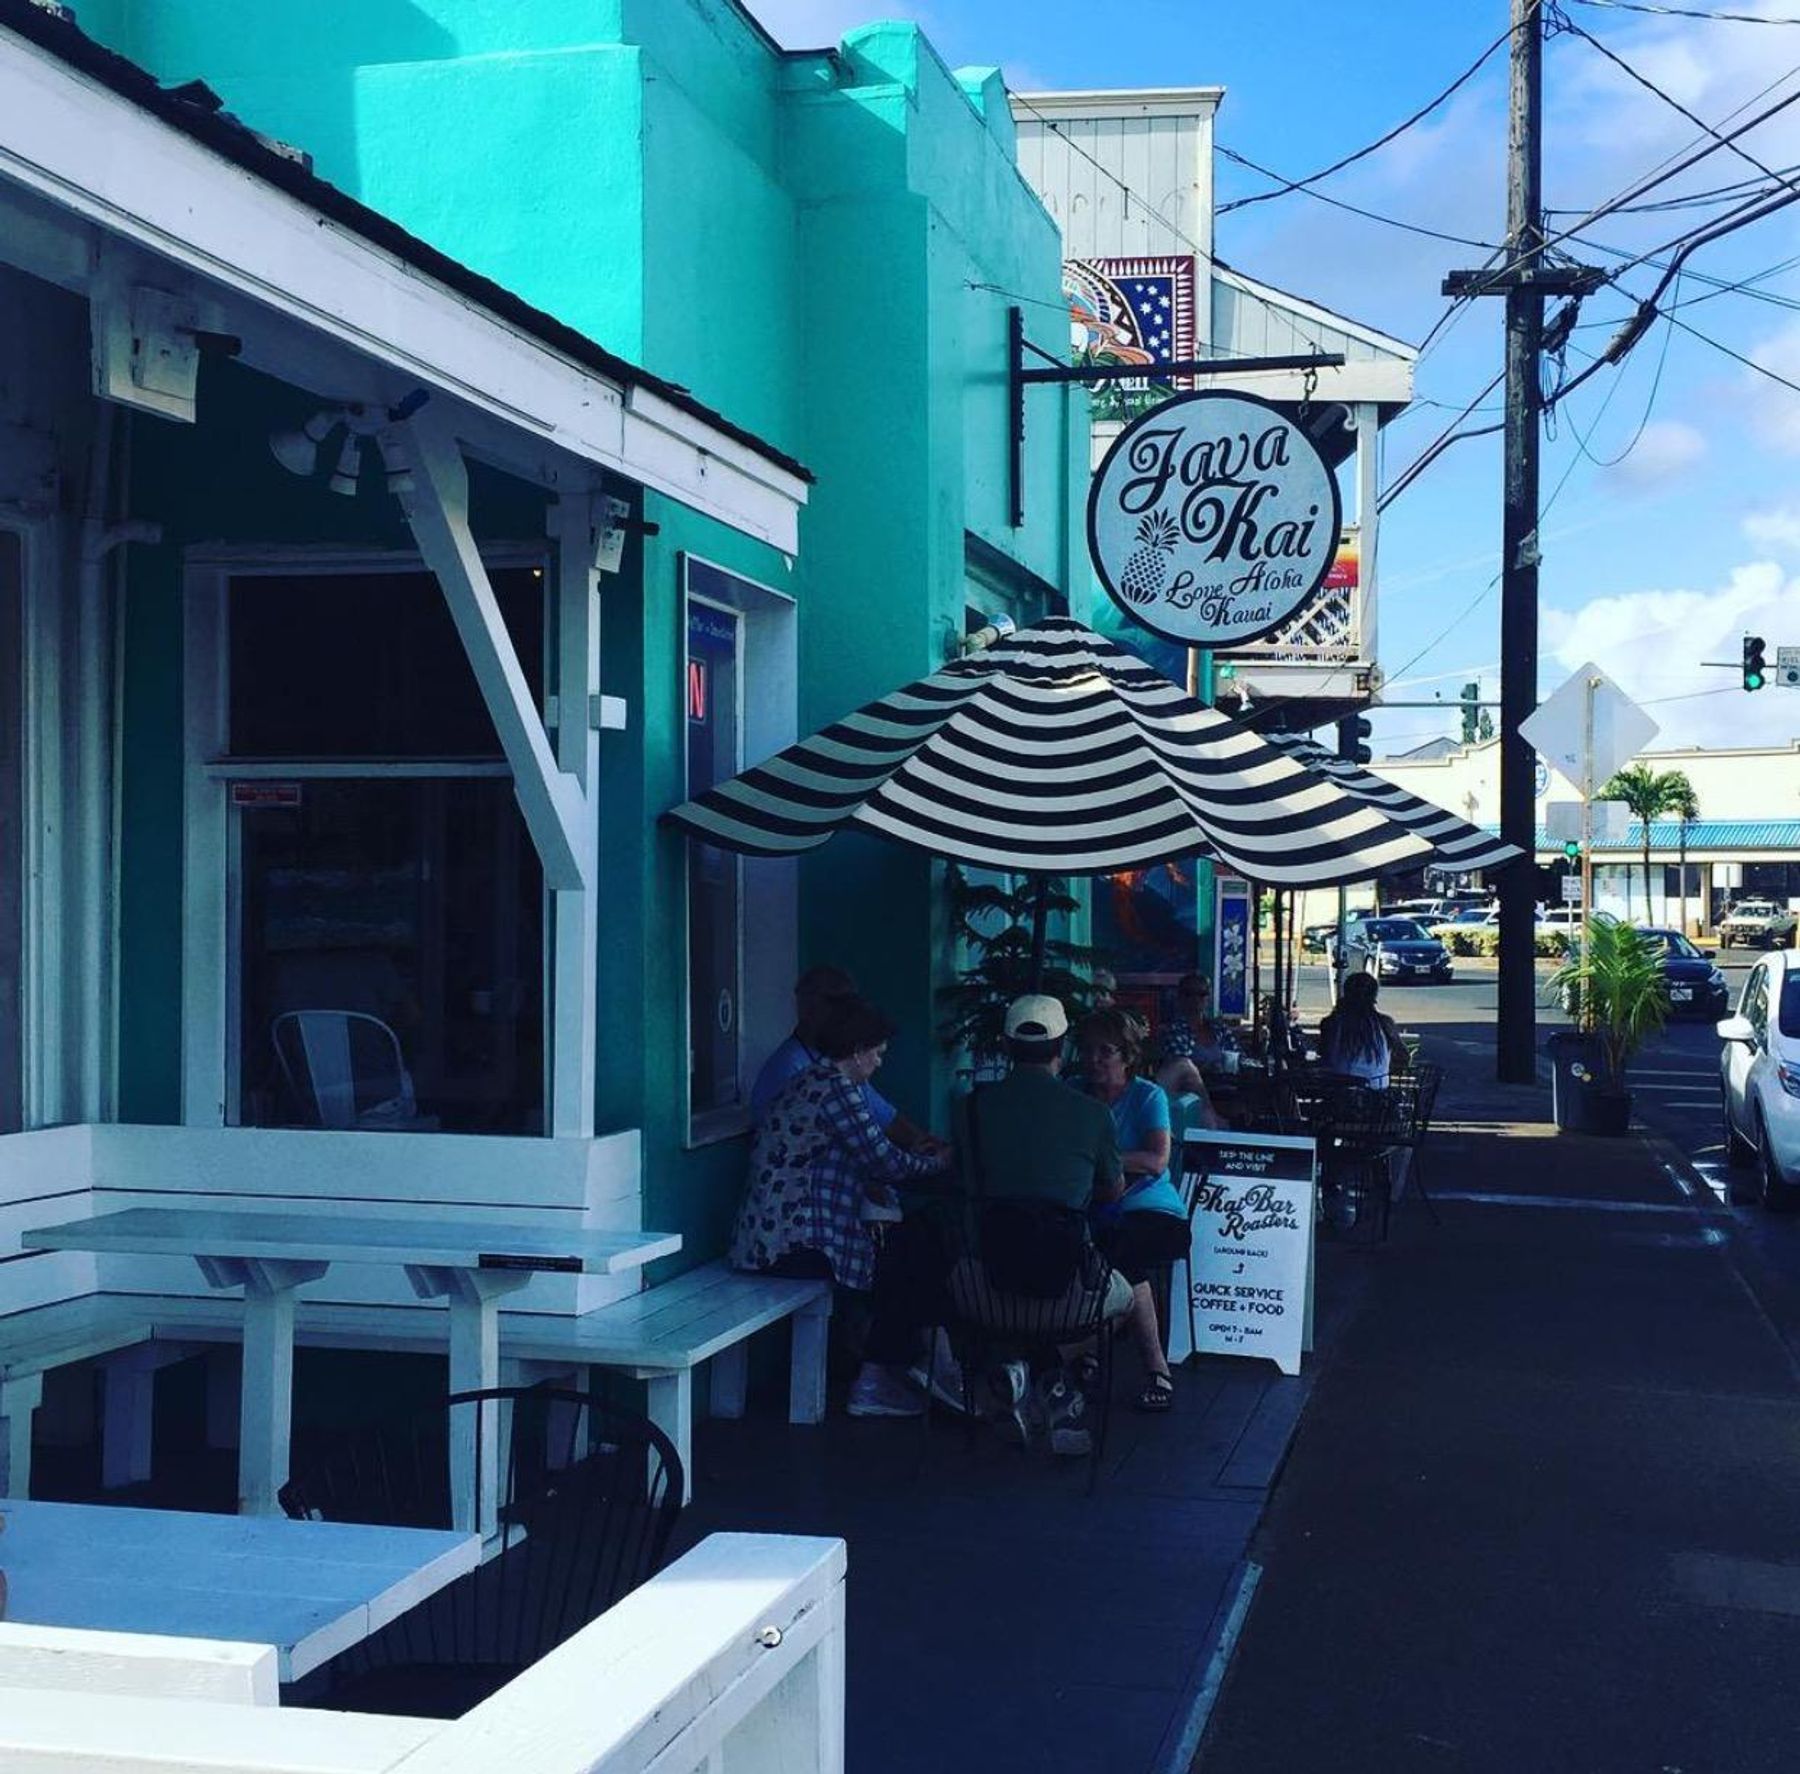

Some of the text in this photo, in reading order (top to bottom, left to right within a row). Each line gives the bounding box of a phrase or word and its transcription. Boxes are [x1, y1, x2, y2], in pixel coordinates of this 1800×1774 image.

[1119, 426, 1290, 514] Java
[1181, 478, 1318, 563] Kai
[1165, 561, 1303, 609] Love Aloha
[1200, 598, 1273, 627] Kauai
[1225, 1162, 1266, 1171] AND VISIT
[1239, 1151, 1254, 1161] THE
[1255, 1152, 1275, 1163] LINE
[1198, 1182, 1296, 1214] Kai Bar
[1218, 1211, 1299, 1241] Roasters
[1193, 1282, 1285, 1301] QUICK SERVICE
[1190, 1297, 1237, 1311] COFFEE
[1248, 1301, 1285, 1316] FOOD
